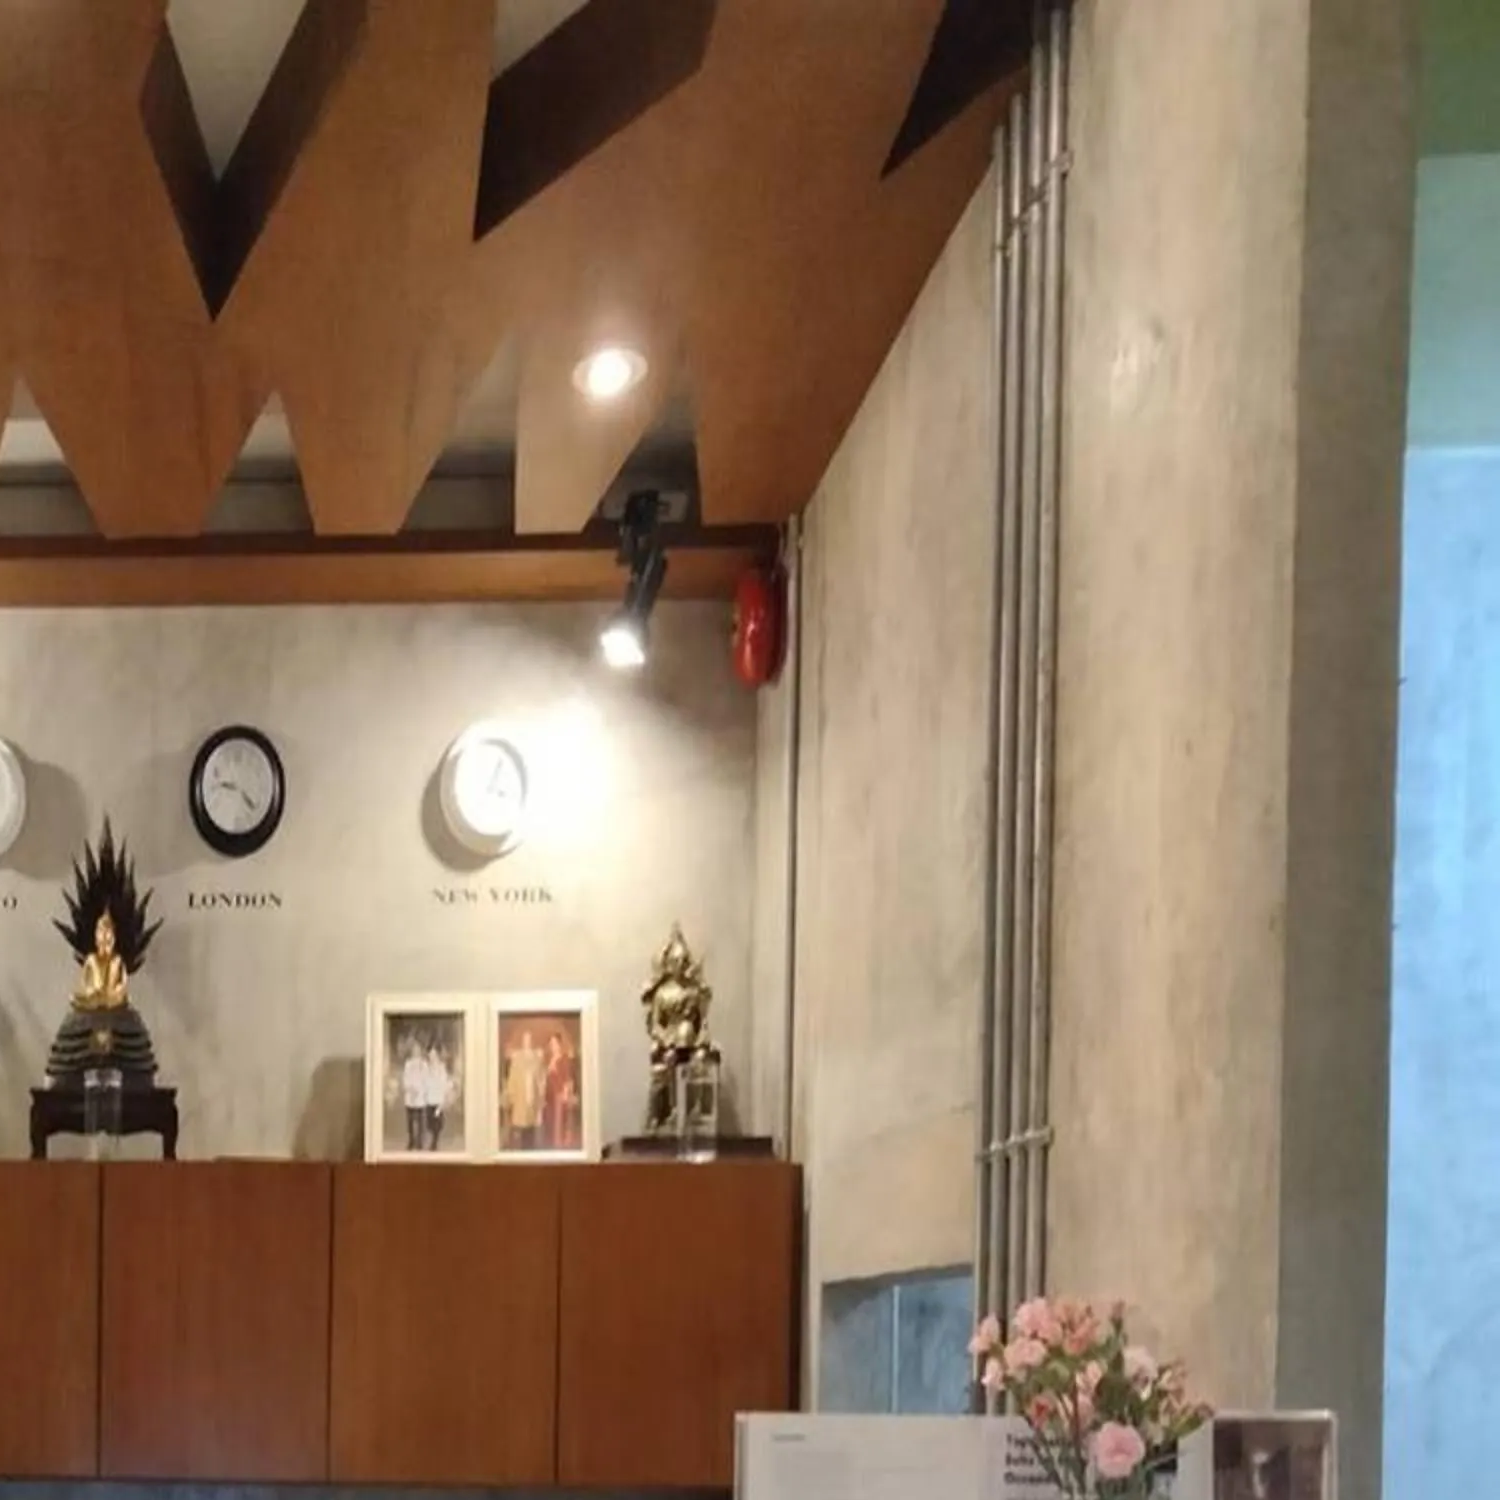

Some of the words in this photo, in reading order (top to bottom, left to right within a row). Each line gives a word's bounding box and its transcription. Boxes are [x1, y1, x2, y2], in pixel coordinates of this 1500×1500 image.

[187, 892, 283, 909] LONDON
[432, 888, 479, 904] NEW
[489, 887, 553, 904] YORK
